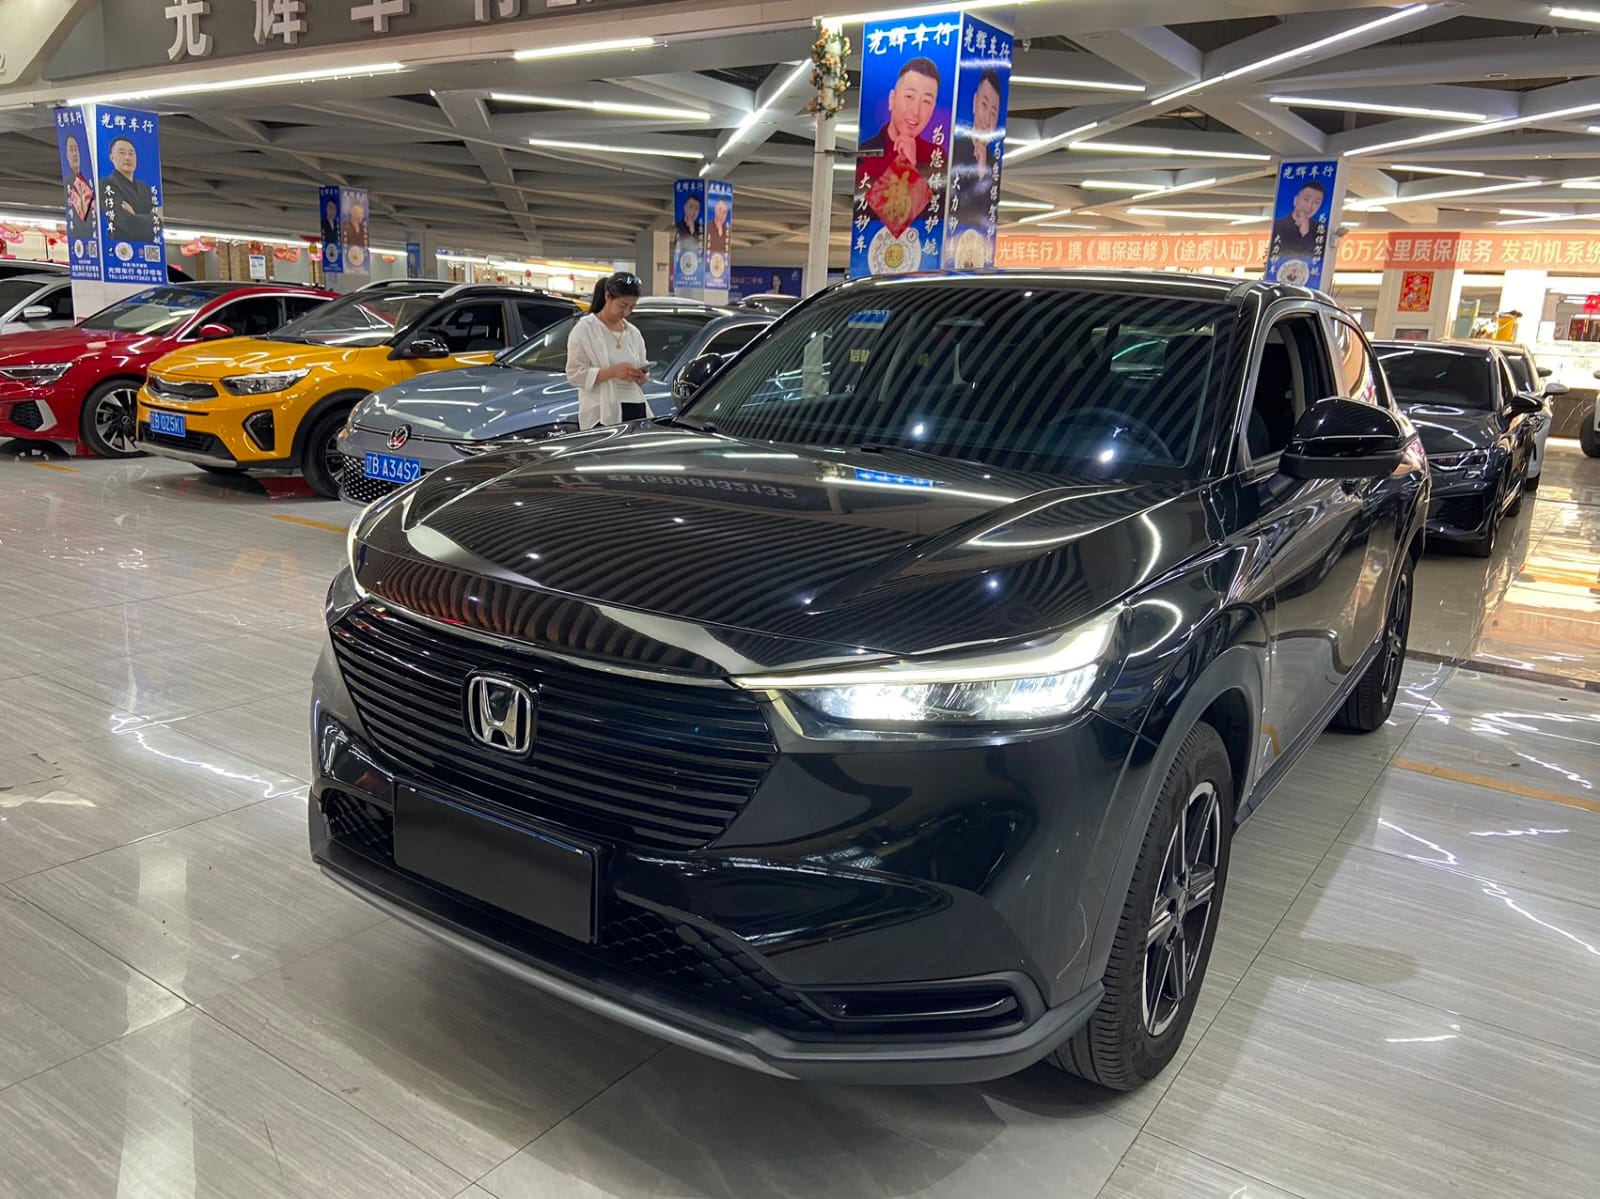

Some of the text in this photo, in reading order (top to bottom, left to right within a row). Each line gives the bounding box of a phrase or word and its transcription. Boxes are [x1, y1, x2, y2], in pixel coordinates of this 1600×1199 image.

[866, 21, 951, 55] 光辉车行
[963, 23, 1011, 60] 光辉车行
[100, 112, 154, 133] 光辉车行
[1283, 165, 1335, 180] 光辉车行
[1340, 239, 1494, 263] 6万公里质保服务
